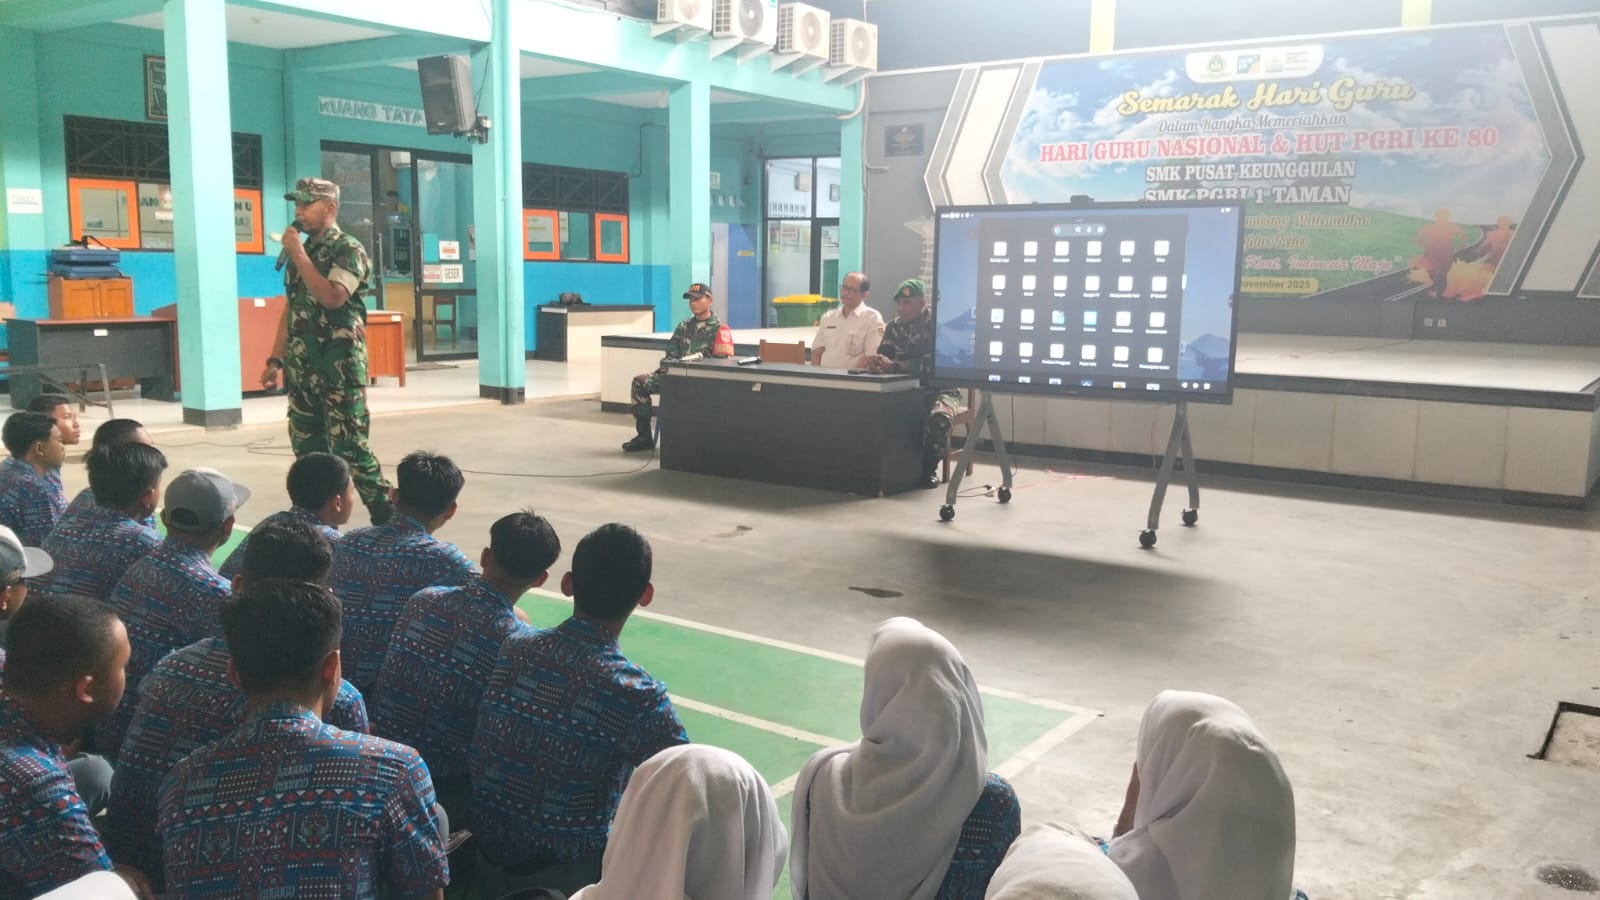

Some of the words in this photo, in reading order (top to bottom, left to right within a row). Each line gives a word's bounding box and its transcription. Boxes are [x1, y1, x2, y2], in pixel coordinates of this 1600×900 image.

[1118, 86, 1240, 116] Semarak
[1247, 81, 1321, 110] Hari
[1327, 76, 1416, 110] Guru
[1158, 119, 1200, 133] Dalam
[1040, 144, 1087, 162] HARI
[1094, 141, 1150, 160] GURU
[1157, 135, 1264, 157] NASIONAL
[1272, 134, 1289, 152] &
[1296, 132, 1344, 151] HUT
[1352, 130, 1415, 150] PGRI
[1423, 128, 1459, 149] KE
[1468, 128, 1497, 147] 80
[1146, 166, 1181, 182] SMK
[1185, 164, 1235, 181] PUSAT
[1239, 161, 1356, 179] KEUNGGULAN
[1144, 189, 1190, 201] SMK
[1255, 188, 1264, 204] 1
[1272, 186, 1352, 204] TAMAN
[1240, 279, 1285, 290] ovember
[1287, 279, 1311, 290] 2025
